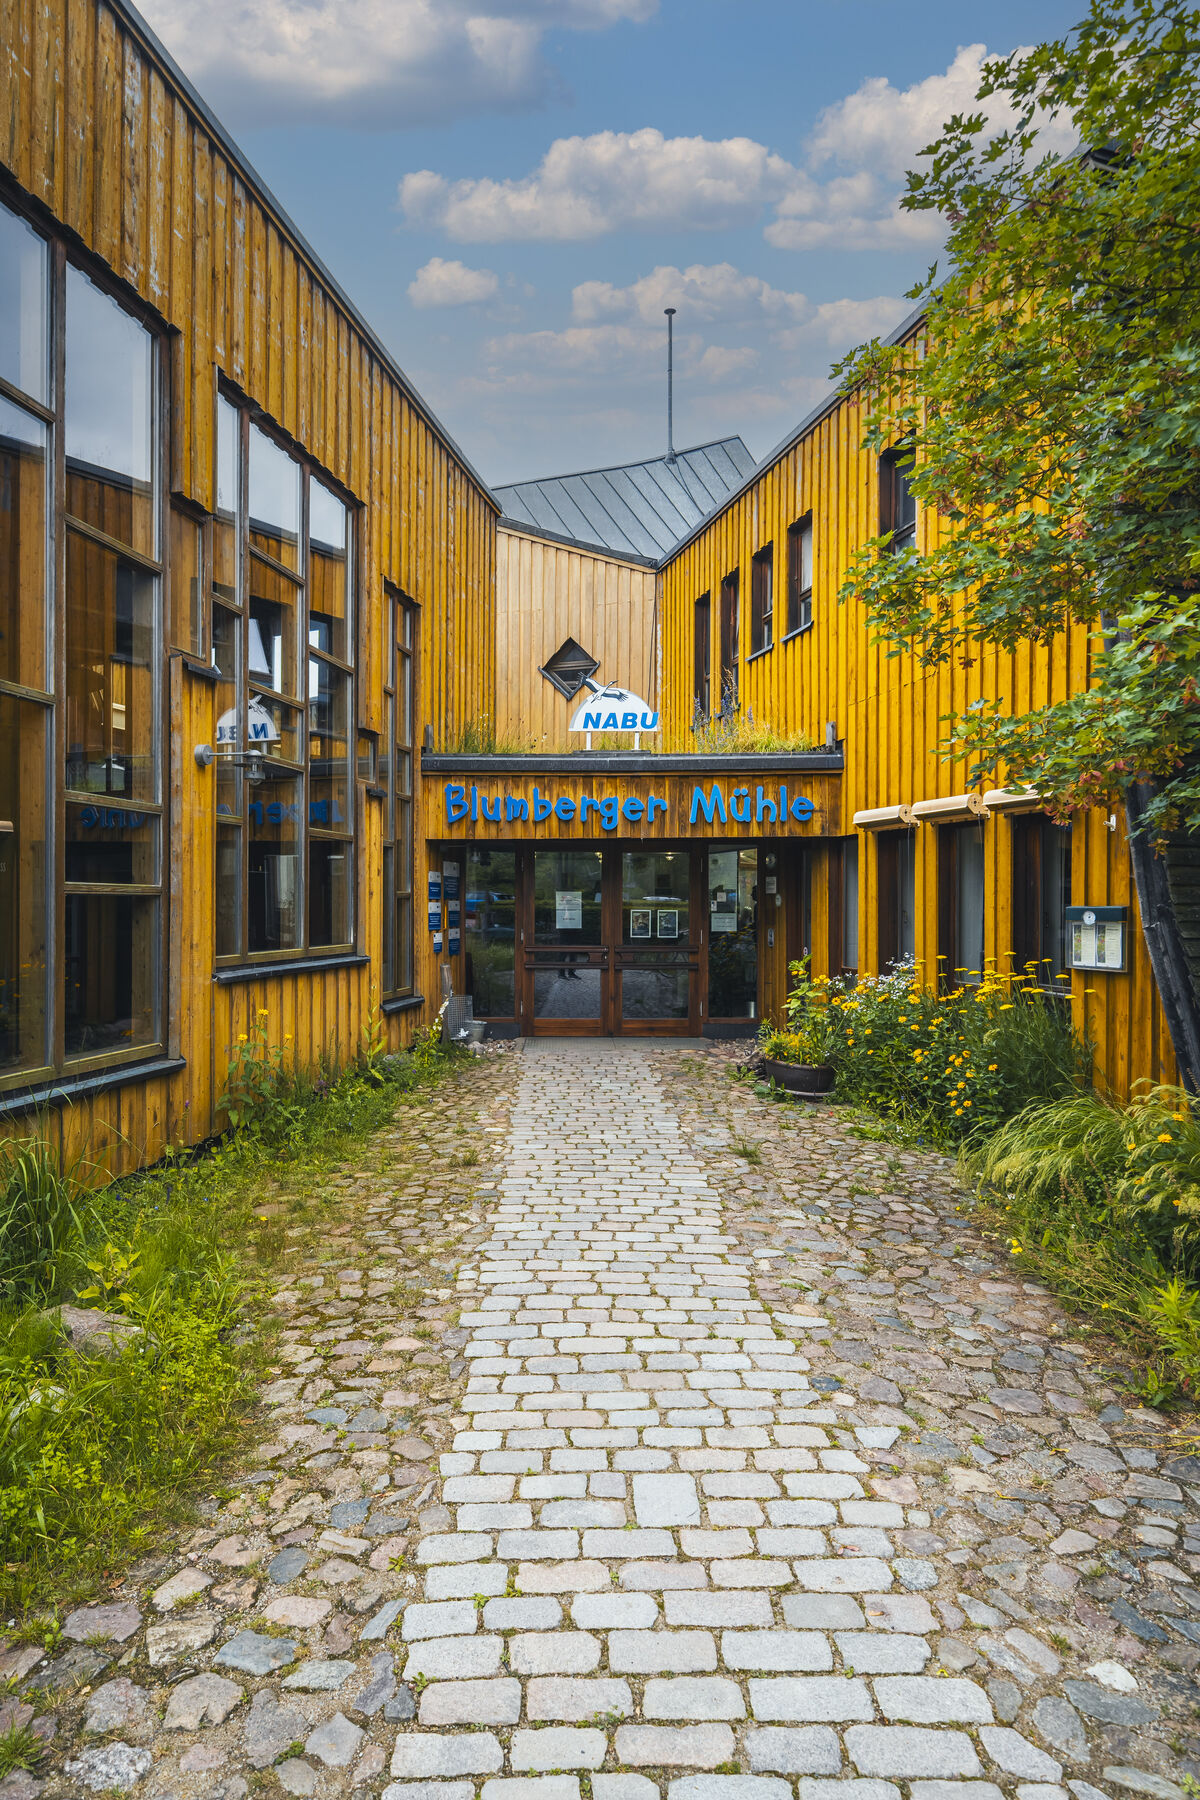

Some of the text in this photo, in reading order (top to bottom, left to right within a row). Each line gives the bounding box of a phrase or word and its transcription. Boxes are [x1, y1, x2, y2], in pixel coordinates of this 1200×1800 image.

[583, 712, 659, 729] NABU
[445, 783, 815, 830] Blumberger Mühle
